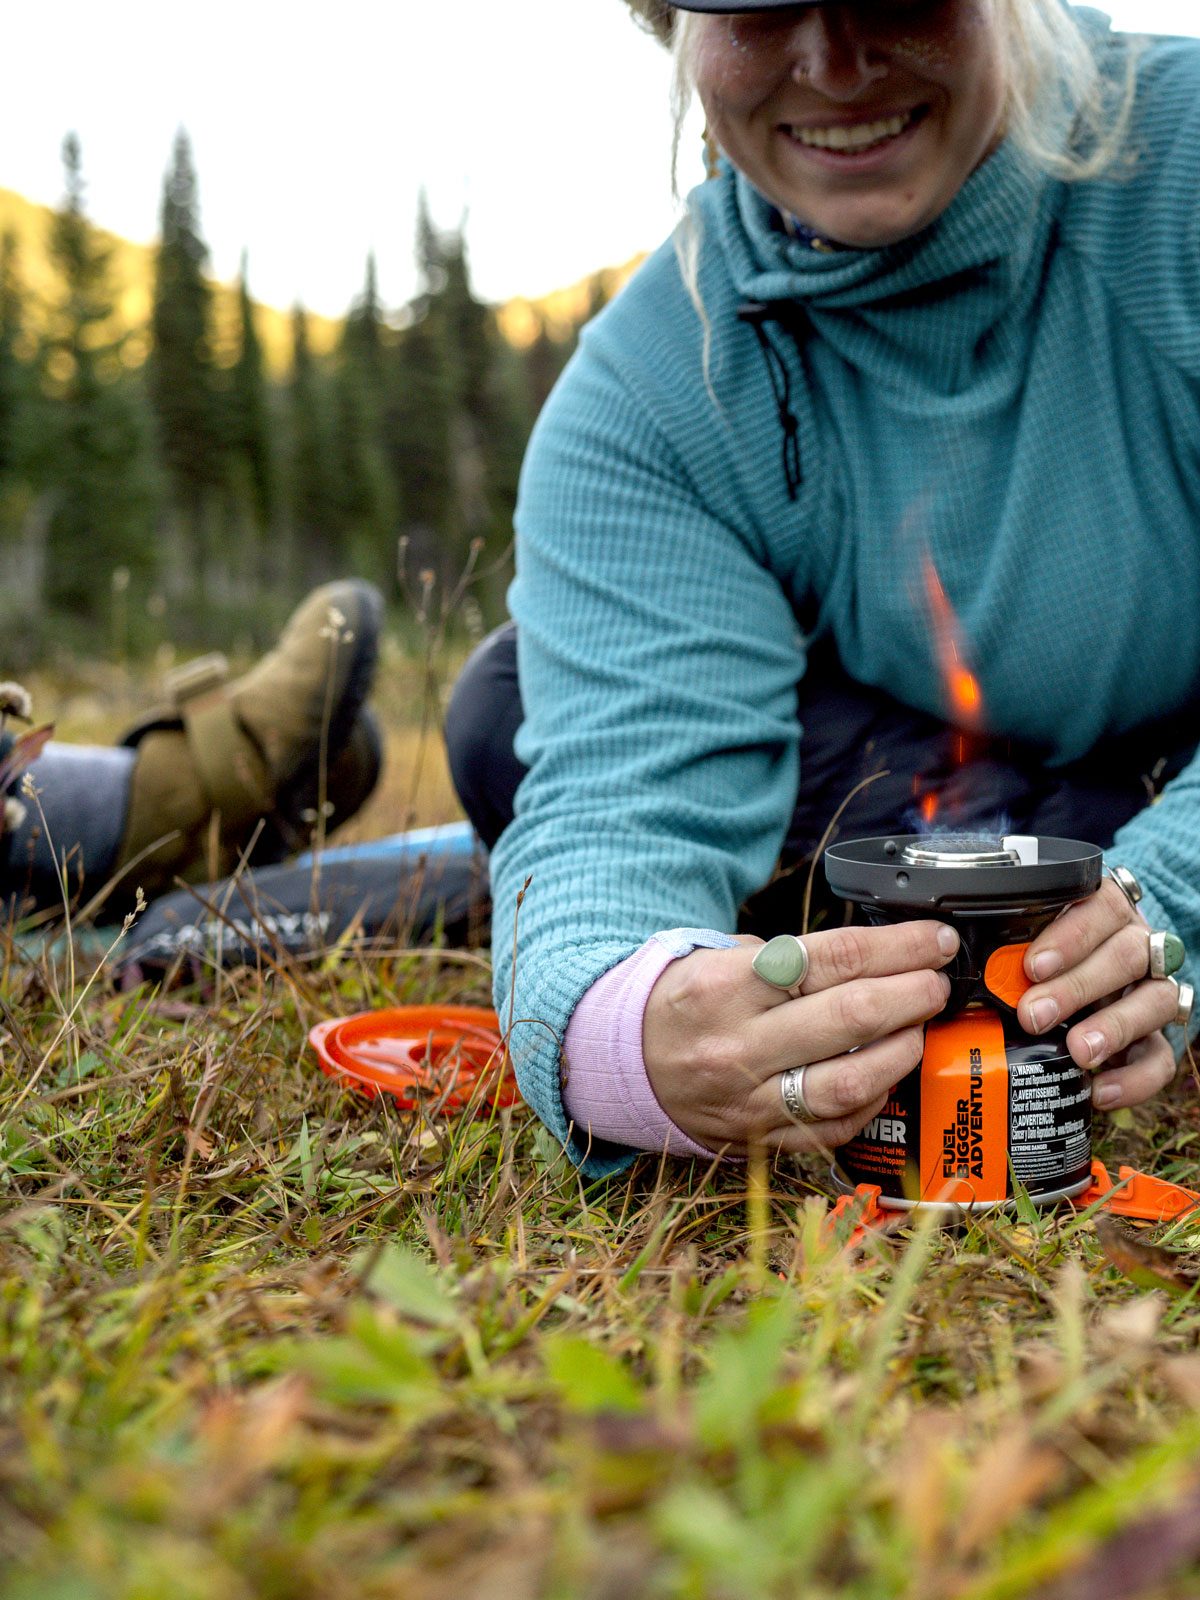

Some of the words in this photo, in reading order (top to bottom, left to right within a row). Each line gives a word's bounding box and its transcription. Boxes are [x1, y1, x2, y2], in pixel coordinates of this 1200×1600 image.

[1017, 1063, 1045, 1075] WARNING:
[1011, 1076, 1025, 1087] Cancer
[1018, 1085, 1060, 1100] AVERTISSEMENT:
[970, 1047, 983, 1180] ADVENTURES
[1011, 1101, 1025, 1113] Cancer
[1018, 1112, 1055, 1127] ADVERTENCIA:
[956, 1098, 970, 1179] BIGGER
[883, 1146, 895, 1155] Fuel
[895, 1147, 906, 1157] Mix
[943, 1123, 956, 1178] FUEL
[1031, 1143, 1048, 1151] DANGER
